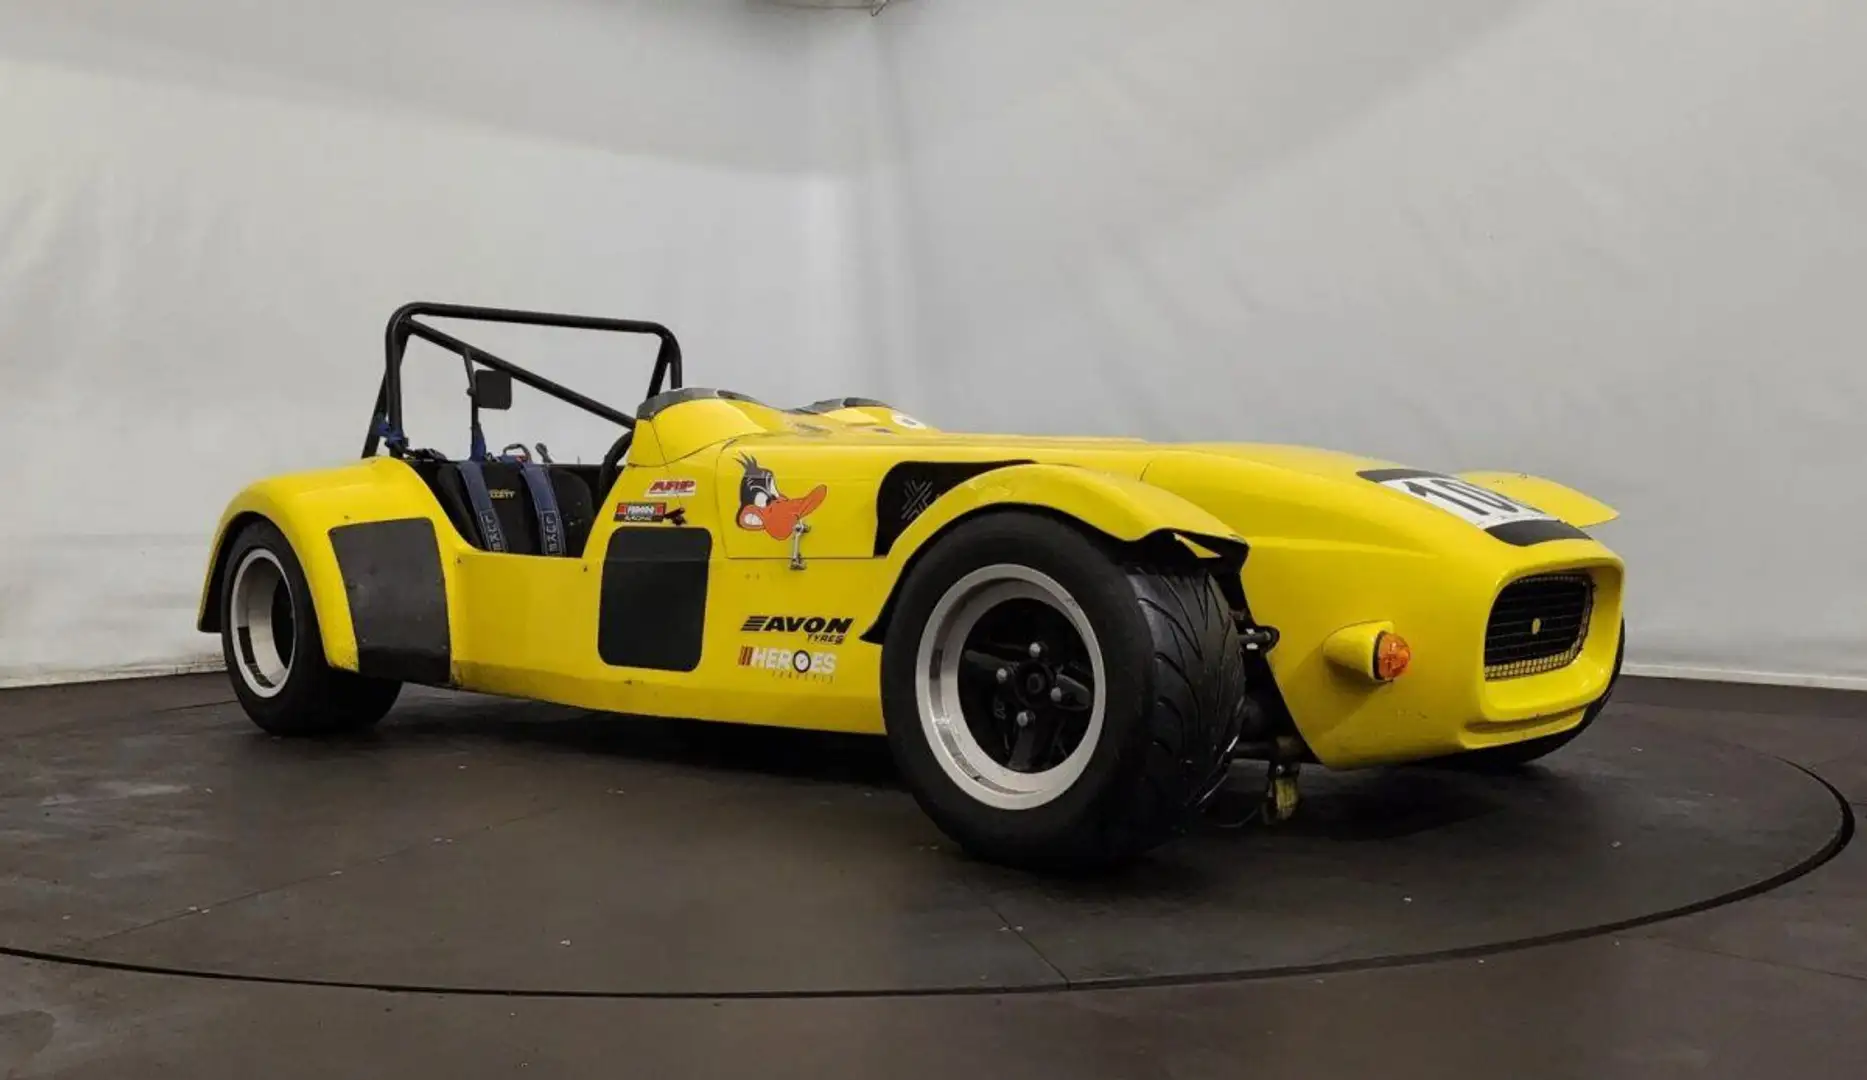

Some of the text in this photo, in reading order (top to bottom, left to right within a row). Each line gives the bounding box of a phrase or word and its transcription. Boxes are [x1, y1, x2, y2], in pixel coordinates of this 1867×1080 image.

[648, 480, 696, 492] ARP
[763, 615, 855, 633] AVON
[806, 632, 846, 645] TYRES
[751, 647, 837, 674] HEROES
